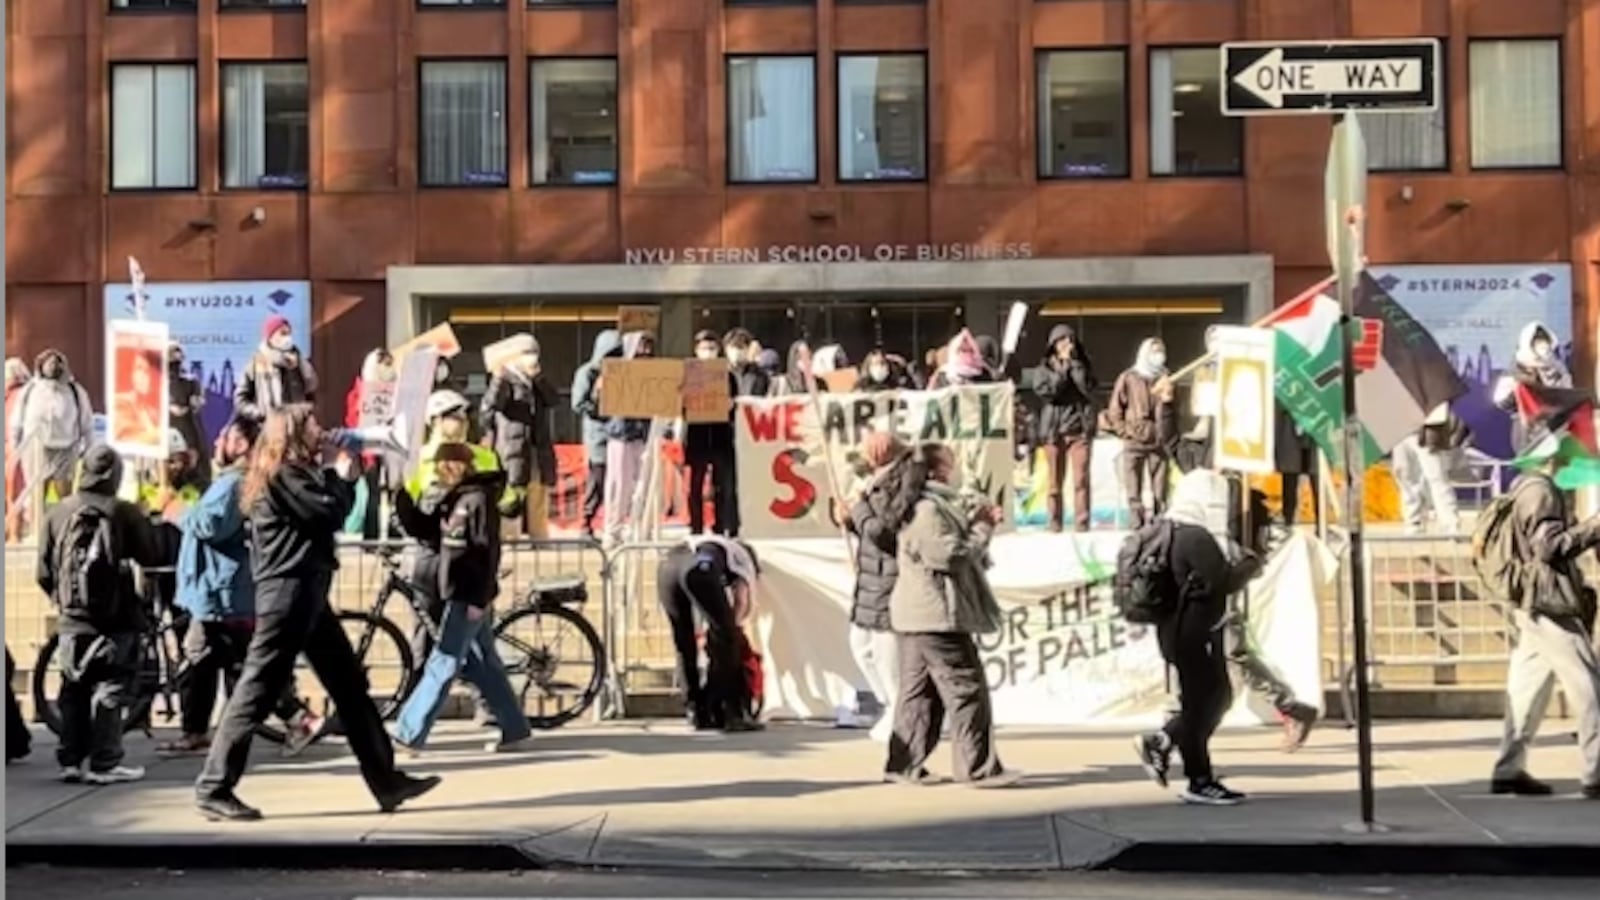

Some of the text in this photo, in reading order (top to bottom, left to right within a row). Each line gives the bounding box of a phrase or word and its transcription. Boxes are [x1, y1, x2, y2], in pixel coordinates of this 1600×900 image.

[1256, 62, 1408, 91] ONE WAY
[625, 241, 1032, 265] NYU STERN SCHOOL OF BUSINESS
[1407, 278, 1522, 291] #STERN2024
[164, 294, 256, 308] #NYU2024
[742, 393, 1007, 445] WE ARE ALL
[1039, 578, 1101, 631] THE
[982, 646, 1027, 692] OF
